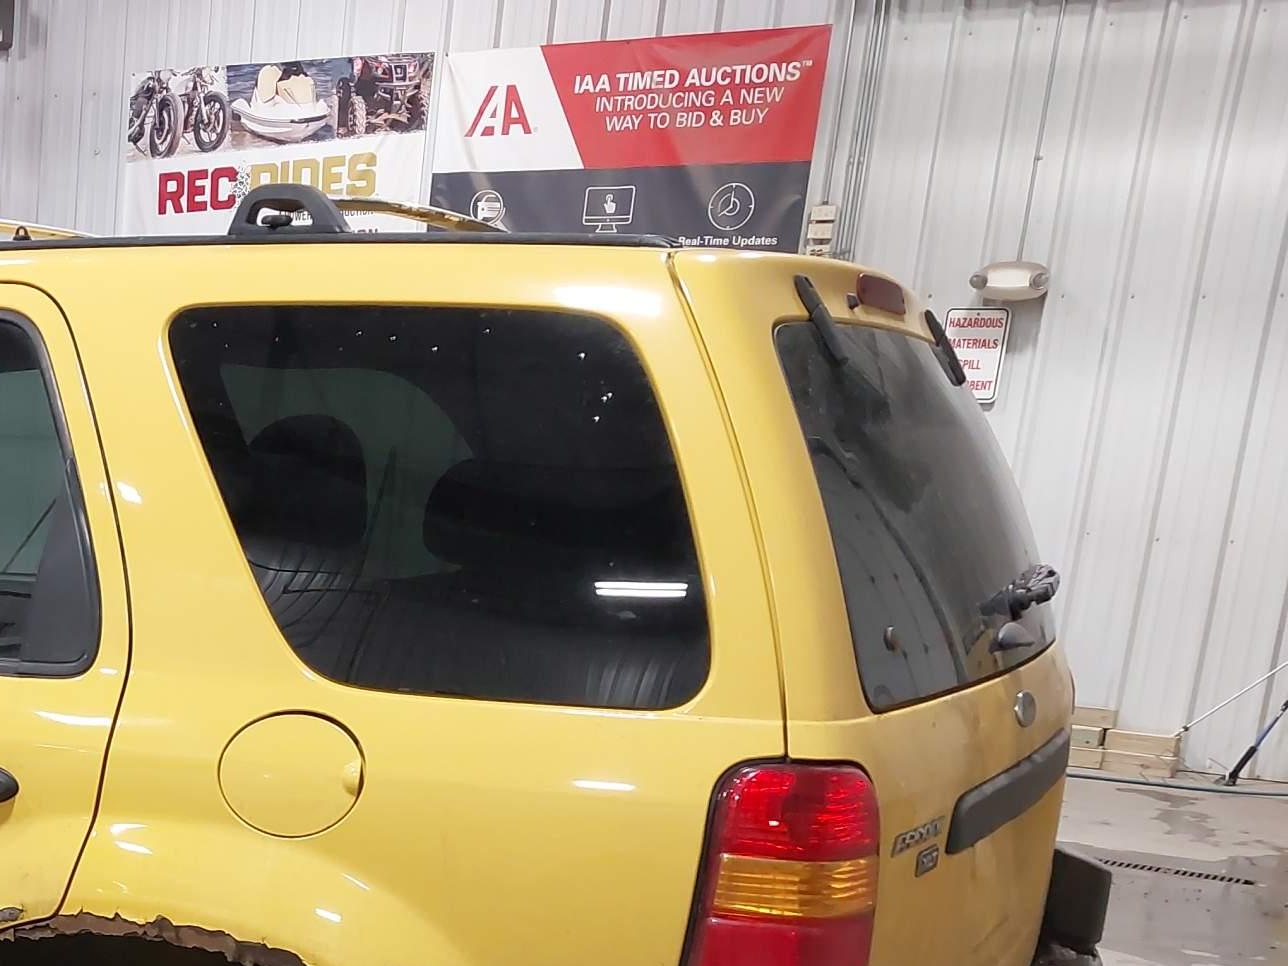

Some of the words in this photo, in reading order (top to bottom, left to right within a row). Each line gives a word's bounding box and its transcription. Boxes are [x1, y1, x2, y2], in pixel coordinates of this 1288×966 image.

[574, 74, 611, 94] IAA
[616, 70, 680, 91] TIMED
[596, 92, 715, 113] INTRODUCING
[720, 91, 733, 107] A
[739, 86, 785, 105] NEW
[605, 114, 643, 132] WAY
[648, 112, 671, 129] TO
[676, 110, 705, 128] BID
[709, 110, 724, 127] &
[729, 107, 769, 126] BUY
[158, 166, 239, 216] REC
[732, 235, 778, 248] Updates
[948, 317, 1004, 329] HAZARDOUS
